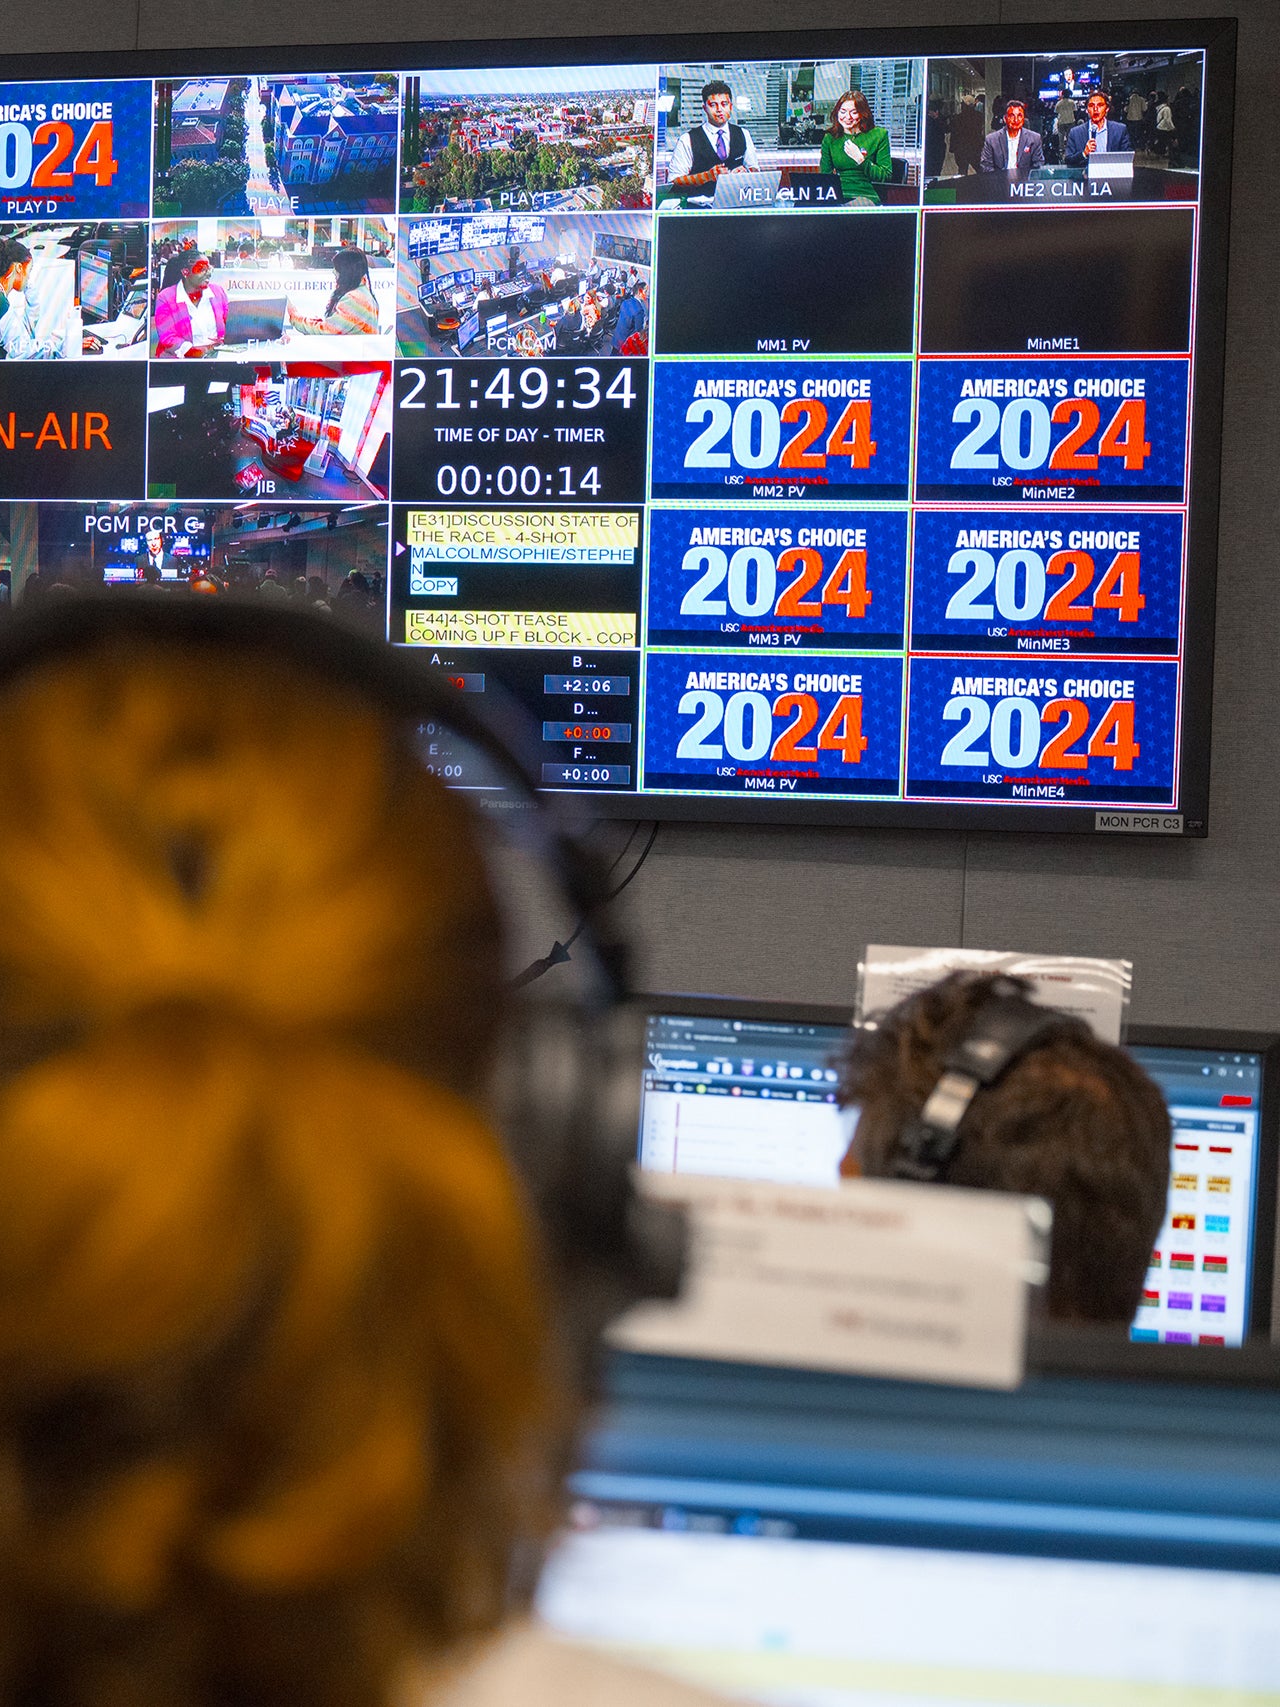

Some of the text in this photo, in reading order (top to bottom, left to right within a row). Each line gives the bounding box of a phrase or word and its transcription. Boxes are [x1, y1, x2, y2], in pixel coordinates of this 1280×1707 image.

[51, 102, 113, 121] CHOICE
[738, 187, 770, 201] ME1
[816, 186, 837, 200] 1A
[1009, 182, 1112, 197] ME2 CLN 1A
[249, 196, 299, 210] PLAY E
[500, 192, 540, 205] PLAY
[7, 201, 57, 214] PLAY D
[257, 280, 281, 291] AND
[283, 280, 335, 291] GILBERT
[487, 337, 557, 350] PCR CAM
[757, 339, 810, 351] MM1 PV
[1027, 338, 1080, 350] MinME1
[399, 367, 637, 410] 21:49:34
[693, 379, 871, 398] AMERICA'S CHOICE
[960, 378, 1146, 398] AMERICA'S CHOICE
[434, 428, 605, 442] TIME OF DAY TIMER
[683, 398, 877, 470] 2024
[950, 397, 1152, 471] 2024
[436, 465, 602, 496] 00:00:14
[724, 475, 744, 485] USC
[992, 476, 1012, 486] USC
[256, 481, 276, 496] JIB
[753, 486, 806, 498] MM2 PV
[1022, 487, 1075, 499] MinME2
[85, 516, 178, 533] PGM PCR
[412, 515, 637, 528] [E31]DISCUSSION STATE OF
[412, 531, 577, 544] THE RACE 4-SHOT
[689, 527, 867, 547] AMERICA'S CHOICE
[955, 529, 1140, 550] AMERICA'S CHOICE
[412, 547, 633, 561] MALCOLM/SOPHIE/STEPHE
[412, 564, 422, 575] N
[411, 580, 457, 592] COPY
[680, 546, 873, 618] 2024
[945, 548, 1146, 623] 2024
[410, 613, 568, 627] [E44]4-SHOT TEASE
[720, 622, 740, 633] USC
[988, 627, 1008, 637] USC
[410, 629, 636, 644] COMING UP F BLOCK COP
[748, 634, 802, 646] MM3 PV
[1017, 638, 1070, 651] MinME3
[563, 679, 611, 692] +2:06
[685, 671, 862, 693] AMERICA'S CHOICE
[950, 676, 1135, 699] AMERICA'S CHOICE
[563, 726, 611, 739] +0:00
[676, 689, 869, 764] 2024
[940, 695, 1141, 771] 2024
[562, 768, 610, 781] +0:00
[716, 766, 735, 777] USC
[744, 778, 797, 791] MM4 PV
[983, 774, 1002, 785] USC
[1012, 785, 1065, 798] MinME4
[480, 798, 538, 810] Panasonic
[1100, 816, 1129, 828] MON
[1133, 817, 1160, 829] PCR
[1163, 818, 1180, 830] C3
